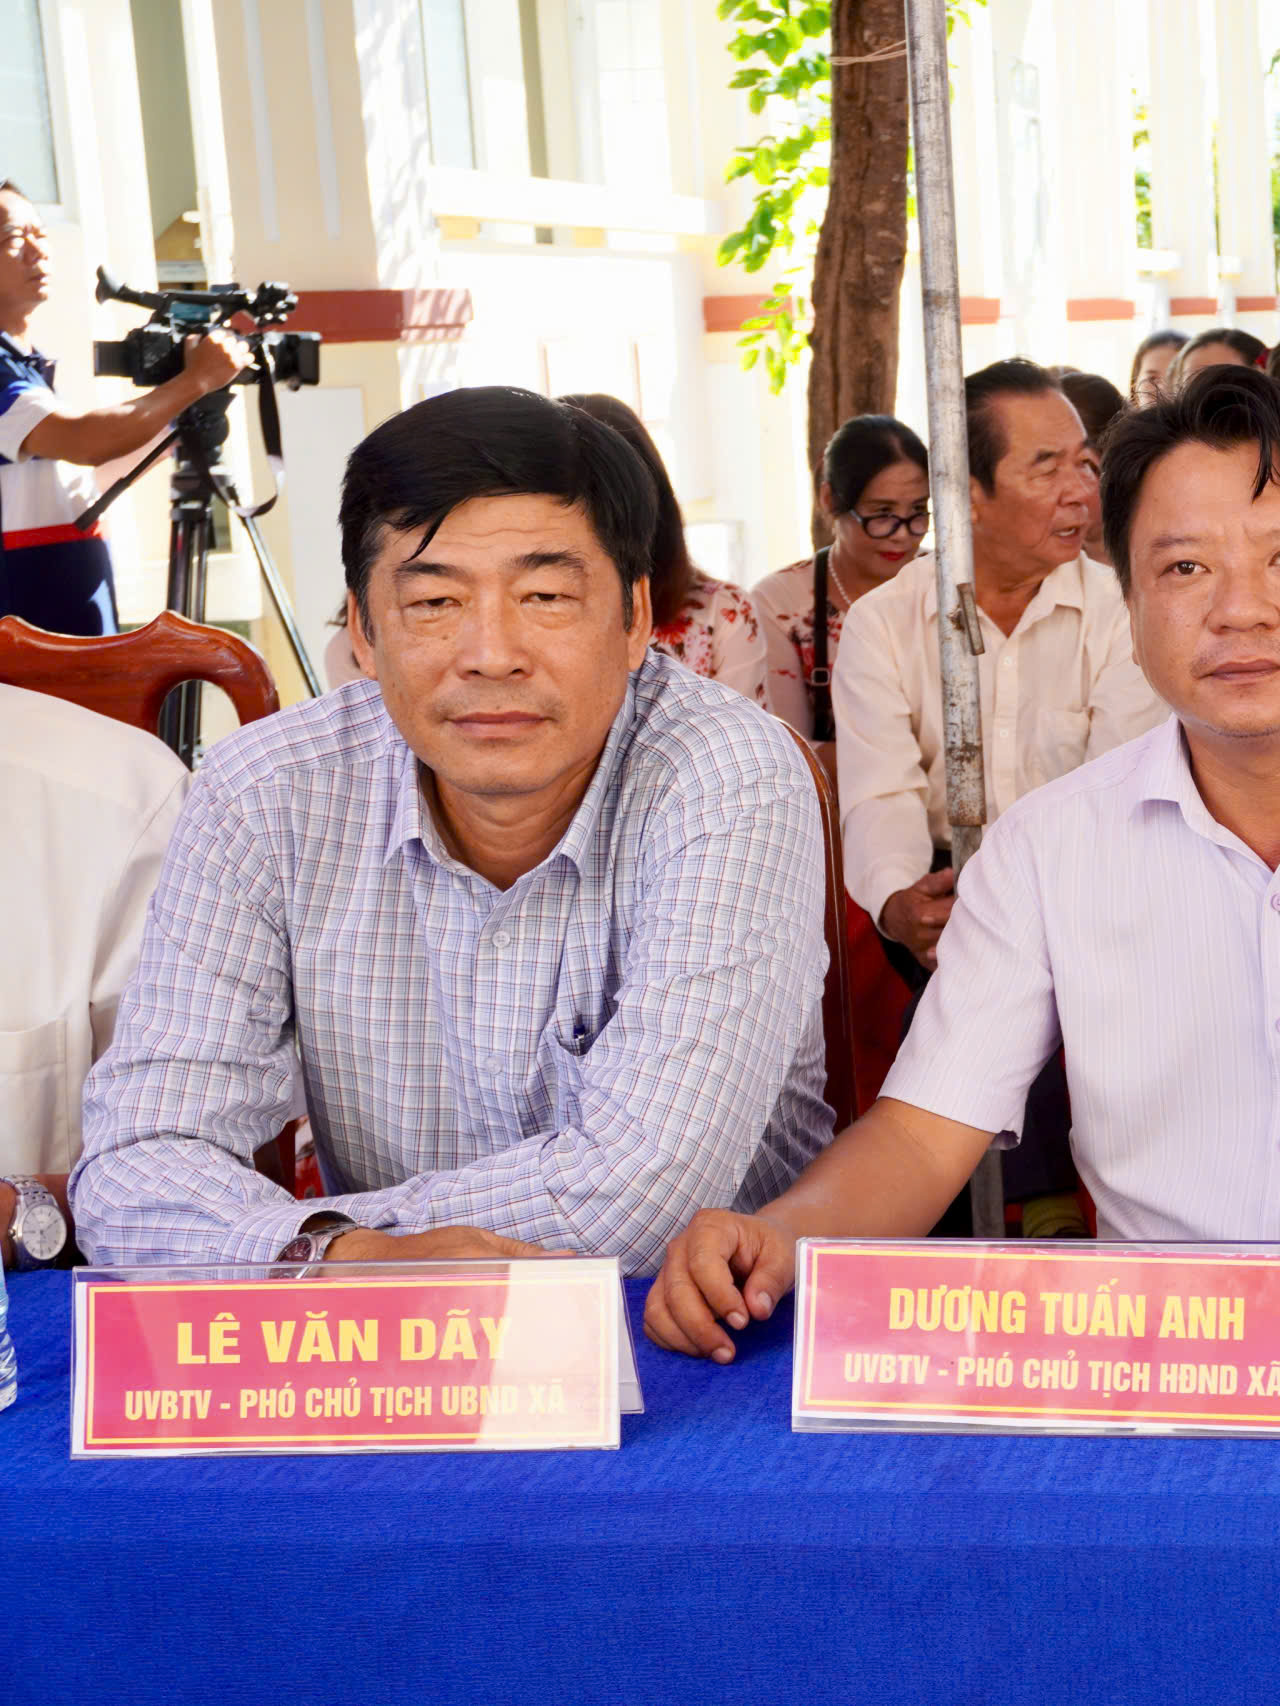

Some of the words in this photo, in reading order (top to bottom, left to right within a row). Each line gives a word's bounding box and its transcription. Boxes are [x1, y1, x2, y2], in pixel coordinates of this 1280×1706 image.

[888, 1285, 1027, 1335] DƯƠNG
[1040, 1278, 1147, 1338] TUẤN
[1158, 1293, 1245, 1341] ANH
[177, 1312, 241, 1365] LÊ
[260, 1310, 379, 1363] VĂN
[400, 1309, 513, 1362] DÃY
[844, 1352, 930, 1386] UVBTV
[955, 1352, 1015, 1388] PHÓ
[1021, 1349, 1080, 1391] CHỦ
[1087, 1359, 1151, 1398] TỊCH
[1159, 1362, 1239, 1396] HĐND
[125, 1390, 212, 1421] UVBTV
[239, 1381, 296, 1419] PHÓ
[305, 1376, 361, 1418] CHỦ
[369, 1386, 433, 1424] TỊCH
[441, 1384, 520, 1417] UBND
[528, 1378, 567, 1414] XÃ
